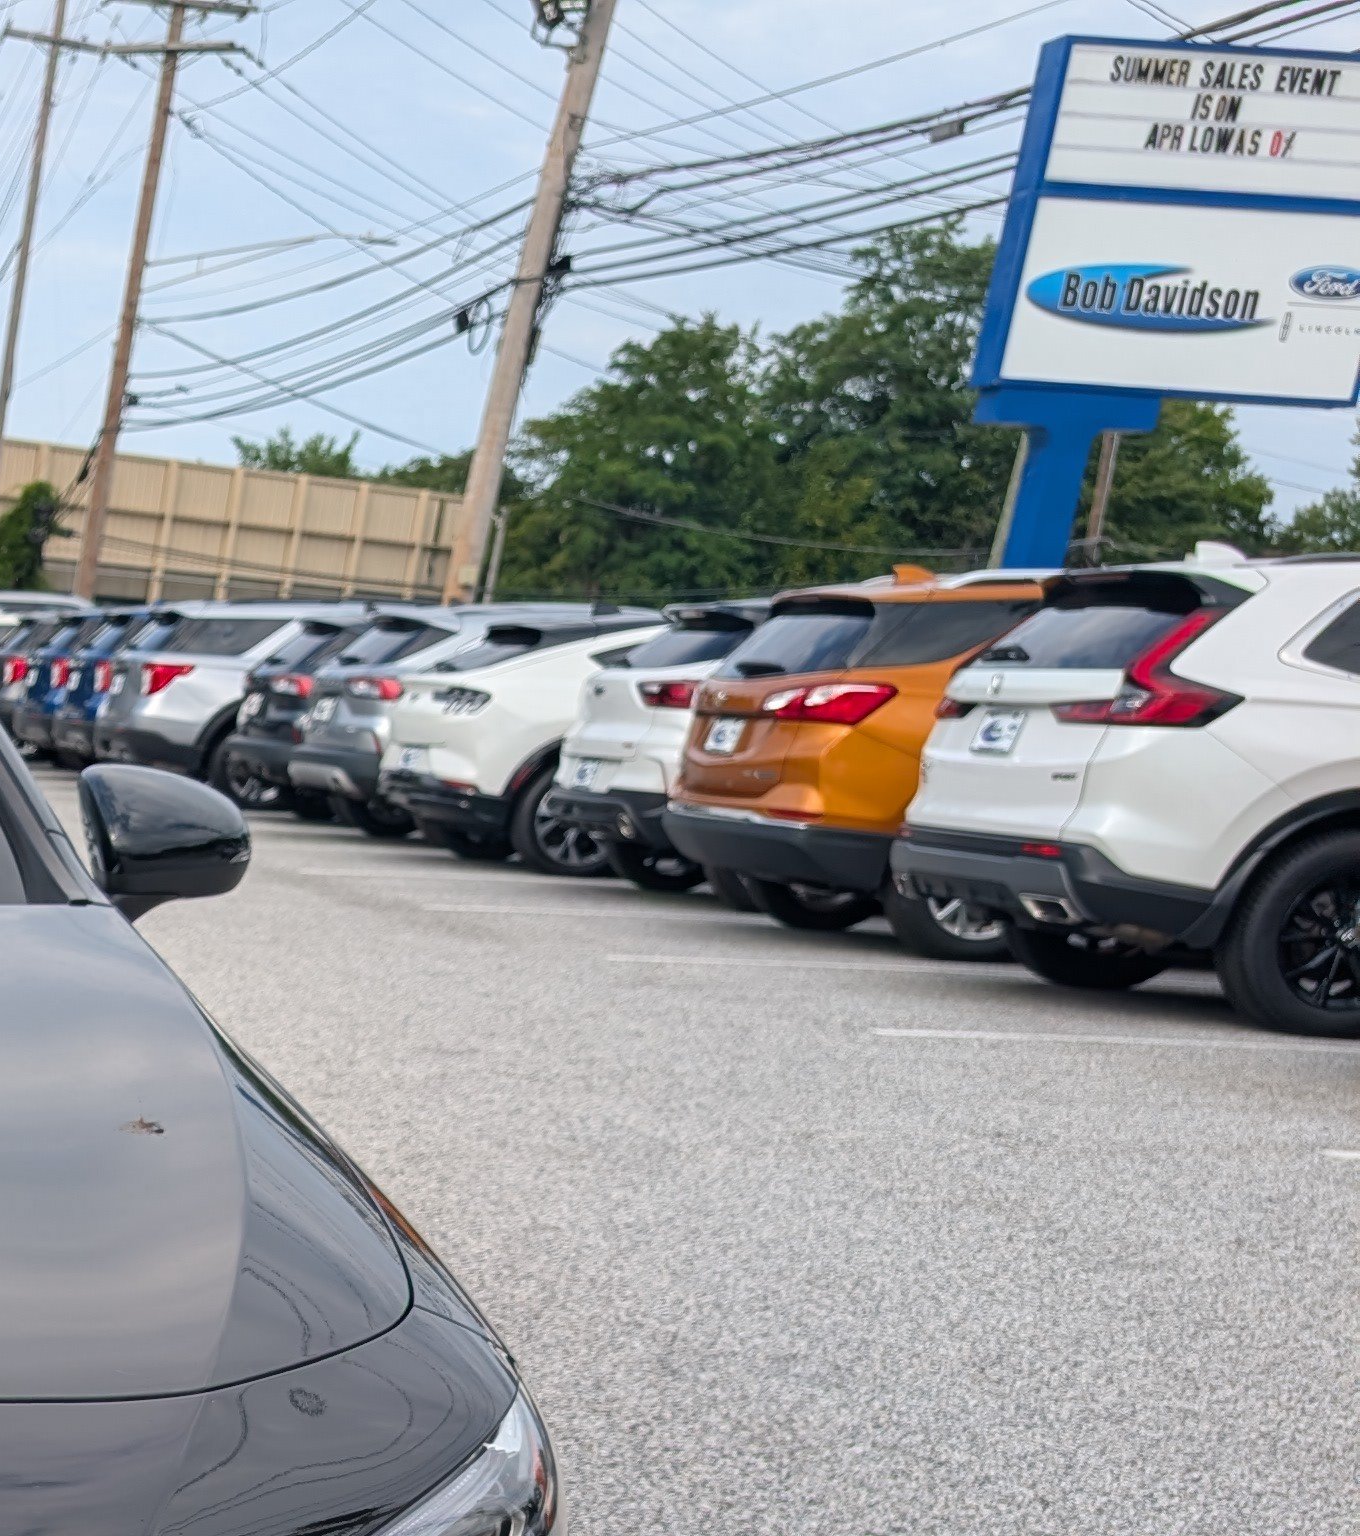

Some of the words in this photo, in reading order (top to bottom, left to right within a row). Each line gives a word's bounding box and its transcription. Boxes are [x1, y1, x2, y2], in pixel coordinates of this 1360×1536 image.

[1109, 55, 1191, 88] SUMMER
[1200, 61, 1264, 91] SALES
[1274, 66, 1342, 96] EVENT
[1144, 122, 1184, 150] APR
[1062, 272, 1116, 313] Bob
[1124, 278, 1261, 321] Davidson
